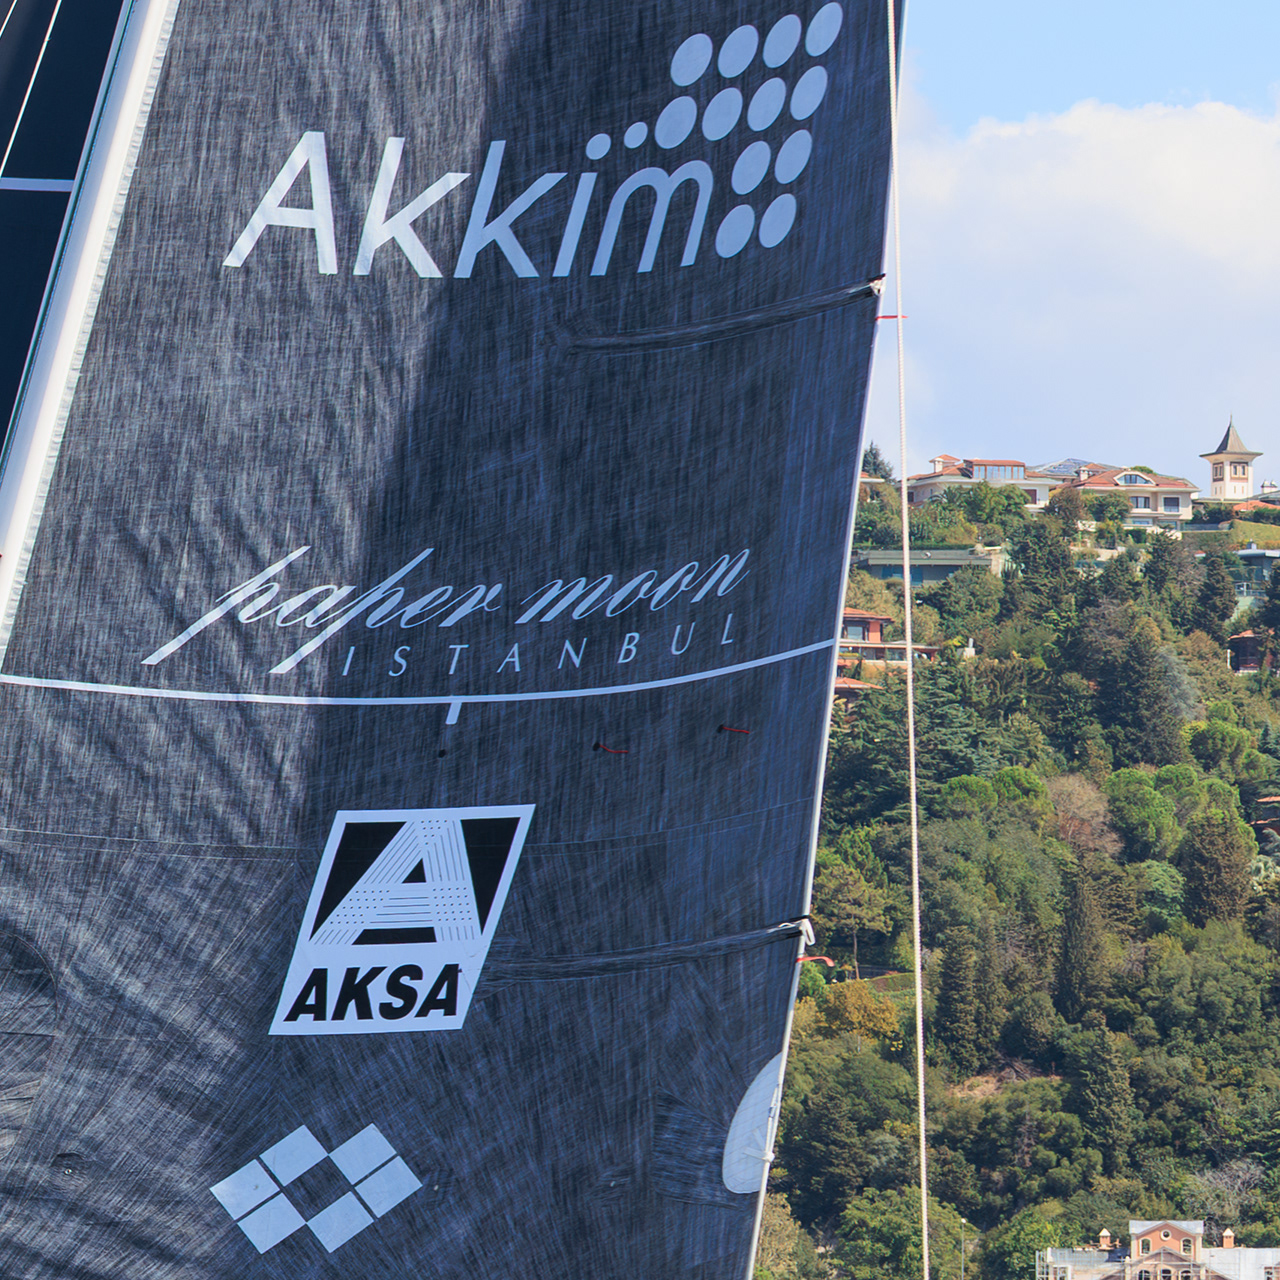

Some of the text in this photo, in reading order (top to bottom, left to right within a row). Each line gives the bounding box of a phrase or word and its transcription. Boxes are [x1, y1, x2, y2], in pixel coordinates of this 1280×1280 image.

[222, 130, 714, 279] Akkim
[141, 545, 750, 676] paper moon
[341, 613, 735, 678] ISTANBUL
[283, 963, 462, 1022] AKSA
